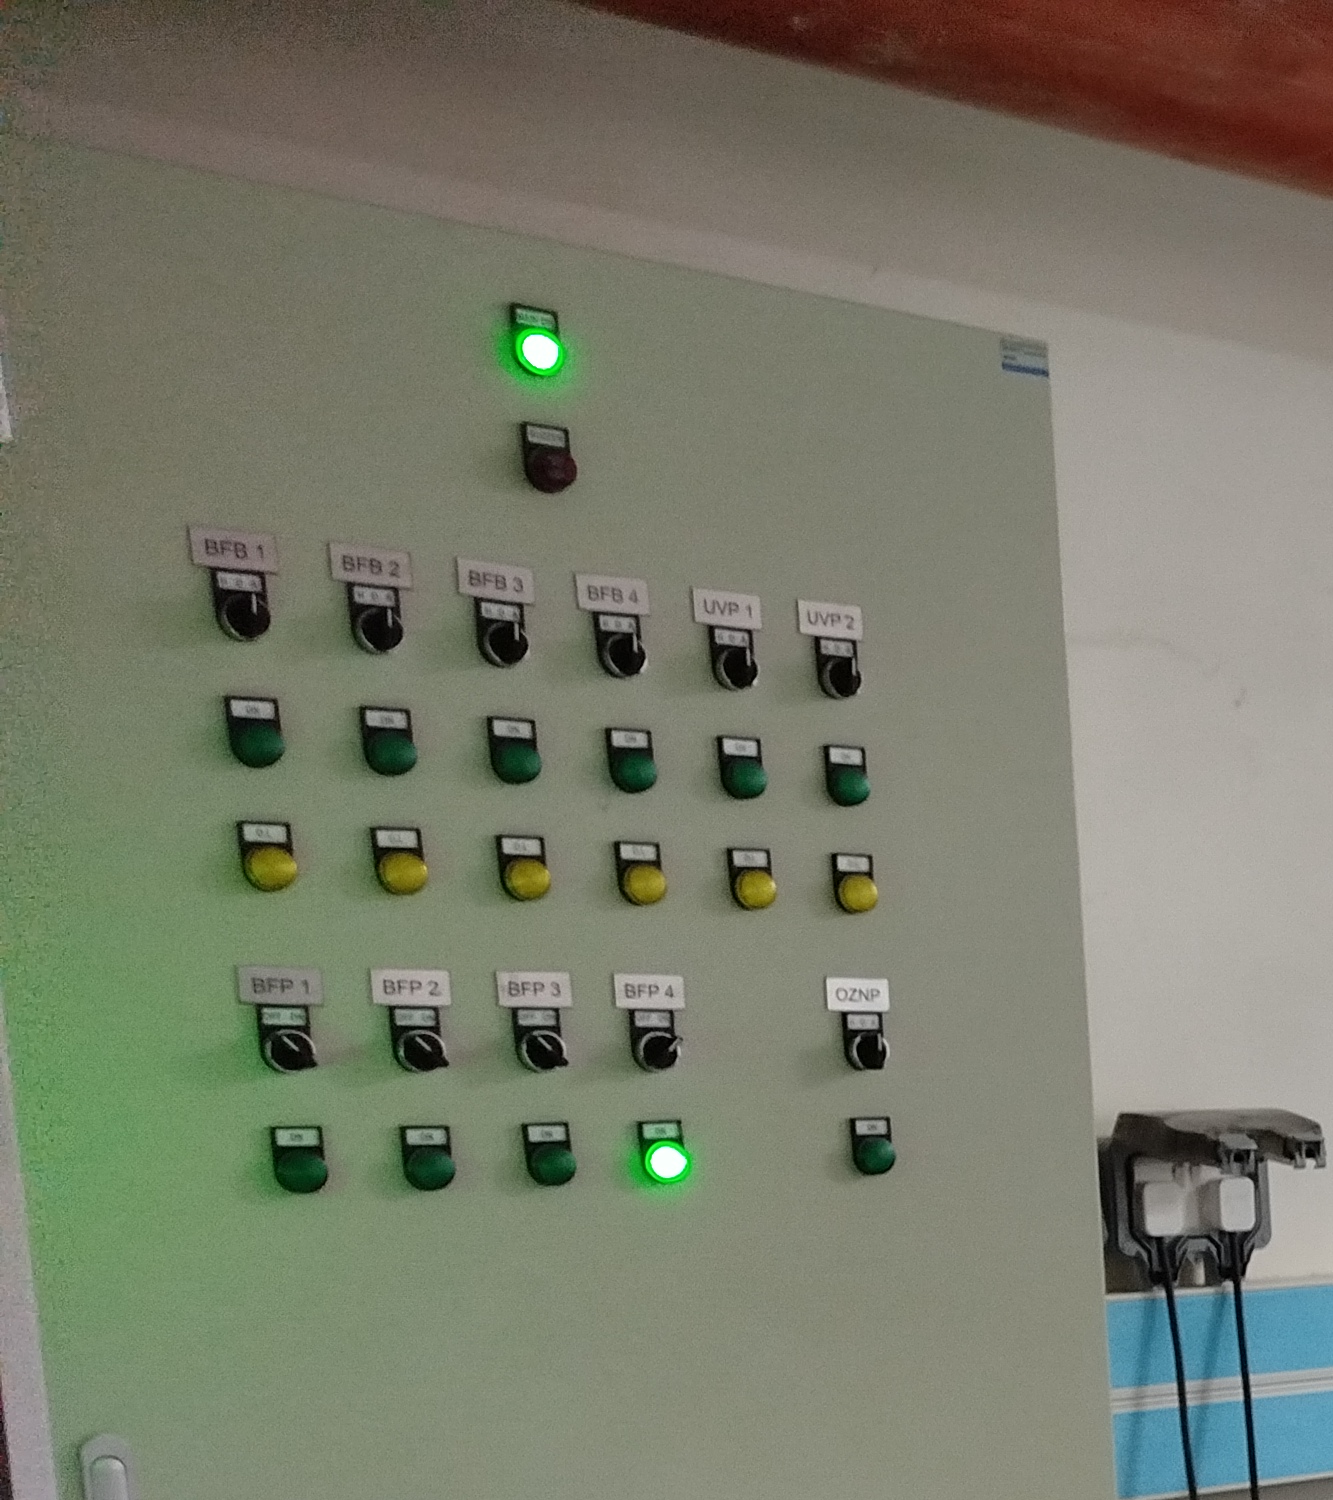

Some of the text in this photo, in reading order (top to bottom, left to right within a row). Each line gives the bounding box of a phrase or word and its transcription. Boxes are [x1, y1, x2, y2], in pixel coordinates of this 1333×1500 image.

[204, 537, 265, 560] BFB 1
[341, 554, 402, 578] BFB 2
[467, 569, 525, 593] BFB 3
[587, 584, 640, 604] BFB 4
[702, 598, 754, 619] UVP 1
[806, 610, 857, 631] UVP 2
[251, 976, 311, 996] BFP 1
[382, 977, 443, 997] BFP 2
[507, 979, 563, 998] BFP 3
[624, 982, 676, 1000] BFP 4
[835, 986, 883, 1003] OZNP
